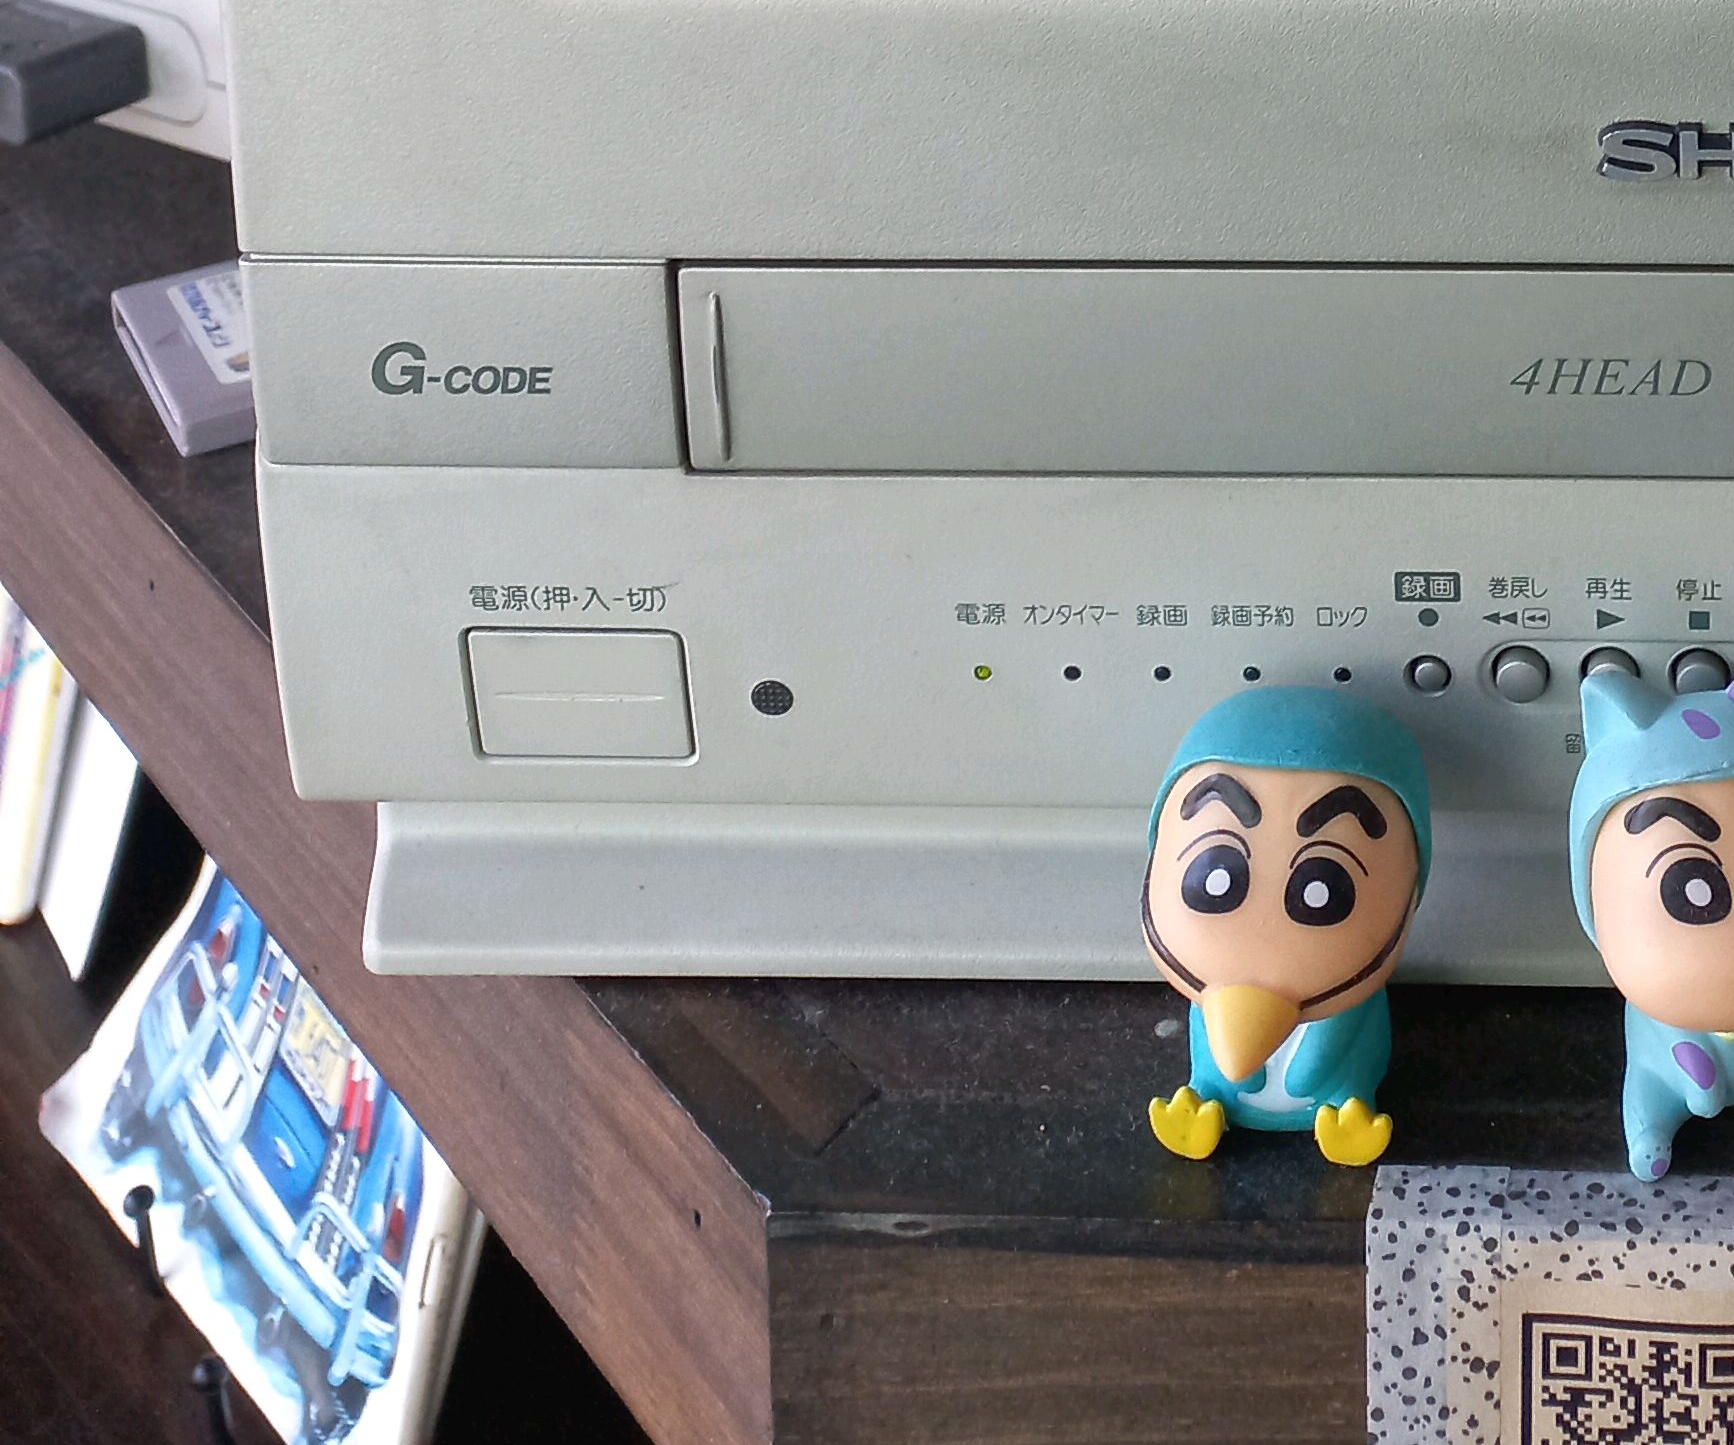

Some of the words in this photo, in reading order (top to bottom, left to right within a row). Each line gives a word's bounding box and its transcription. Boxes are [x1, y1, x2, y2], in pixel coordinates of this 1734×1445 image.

[370, 341, 554, 396] G-CODE
[1508, 357, 1713, 398] 4HEAD
[1399, 573, 1458, 600] 録画
[1487, 576, 1549, 601] 巻戻し
[1585, 577, 1633, 602] 再生
[1675, 578, 1723, 602] 停止
[954, 602, 1007, 626] 電源
[1022, 604, 1120, 627] オンタイマー
[1136, 604, 1188, 627] 録画
[1210, 604, 1295, 628] 録画予約
[1316, 606, 1369, 629] ロック
